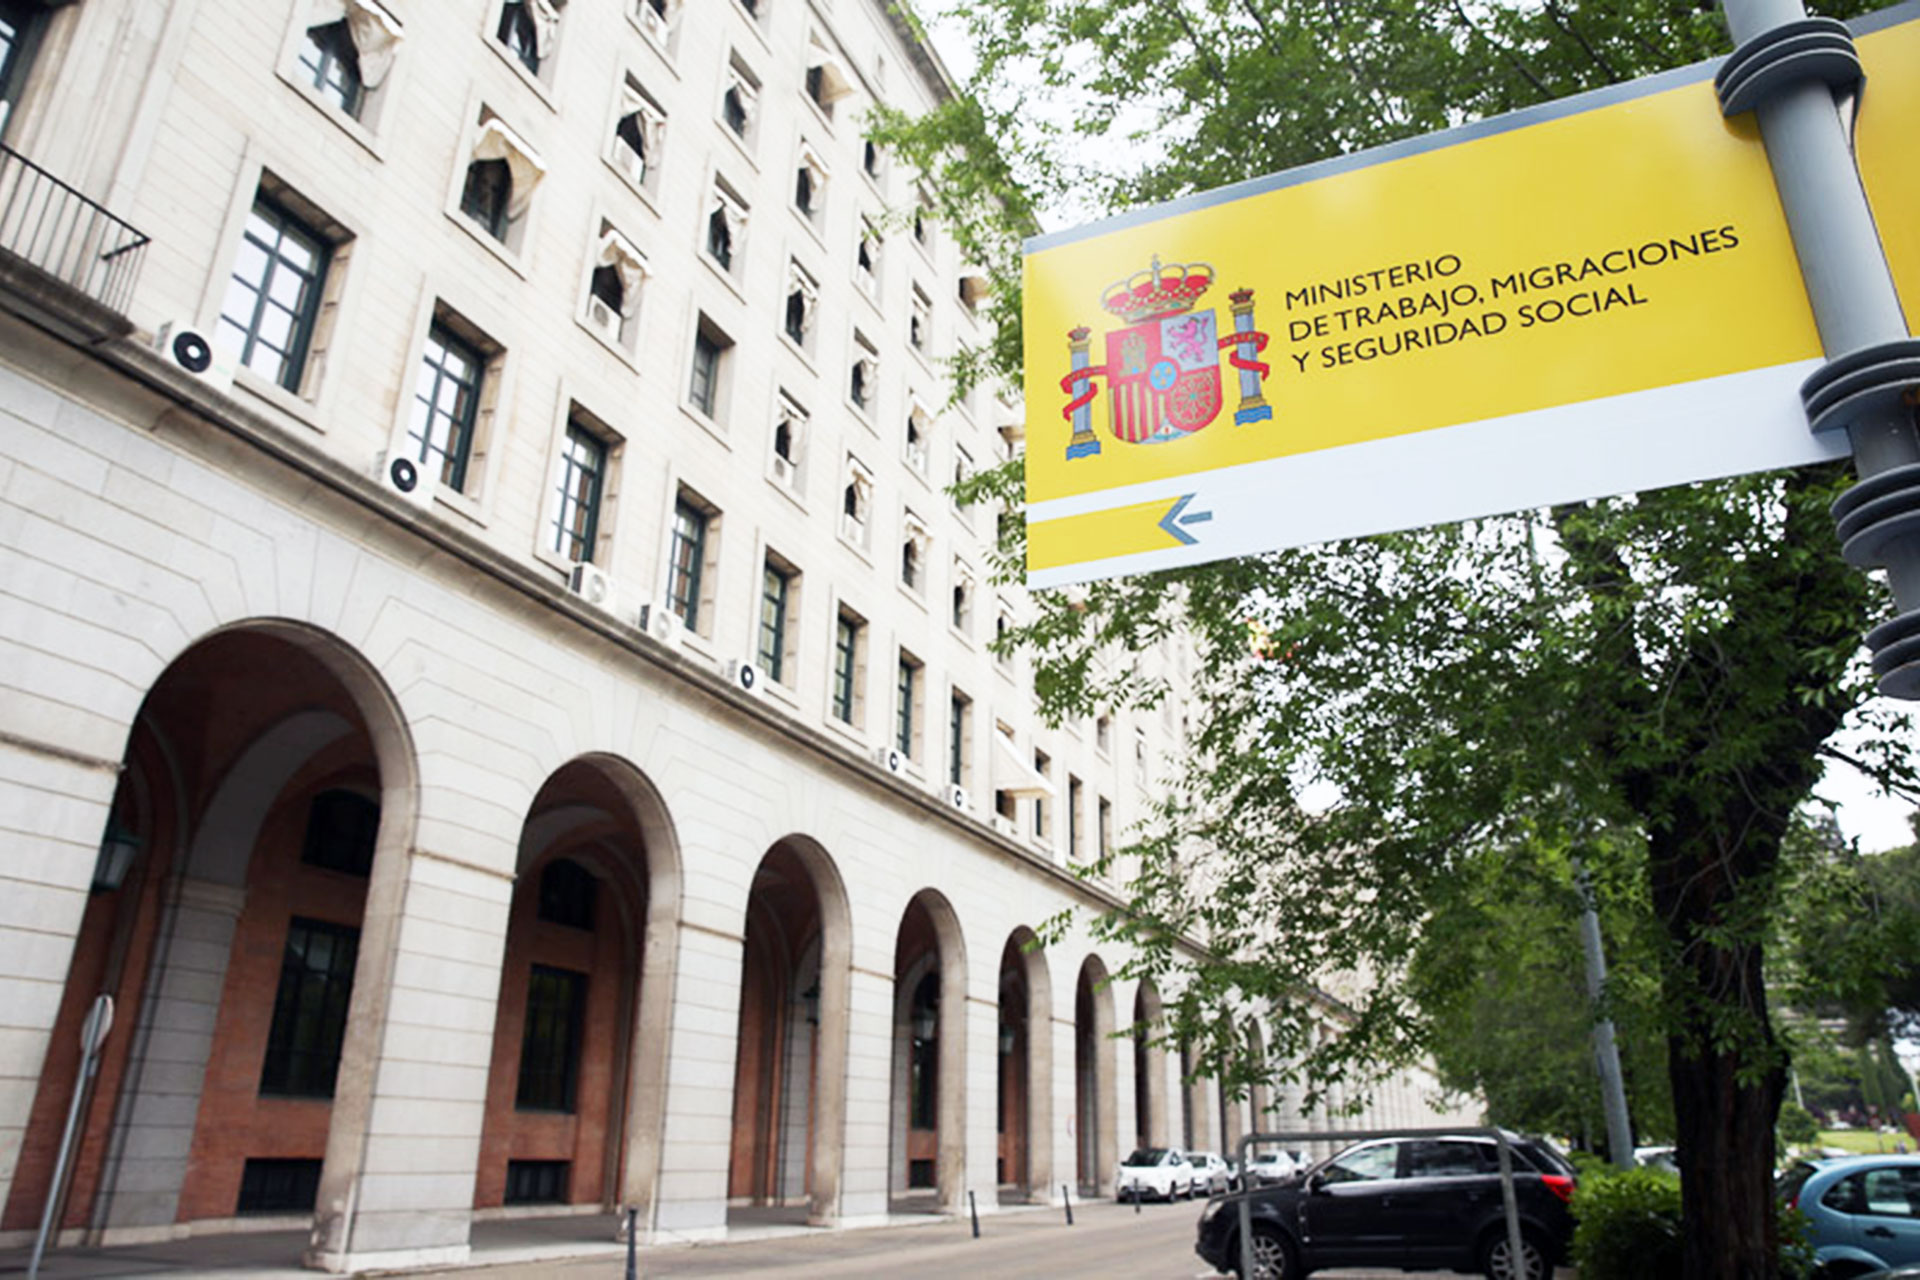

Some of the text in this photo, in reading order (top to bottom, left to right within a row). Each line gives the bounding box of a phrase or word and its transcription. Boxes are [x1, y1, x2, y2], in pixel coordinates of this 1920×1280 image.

[1285, 254, 1462, 311] MINISTERIO
[1289, 225, 1739, 342] DE TRABAJO, MIGRACIONES
[1292, 283, 1648, 373] Y SEGURIDAD SOCIAL
